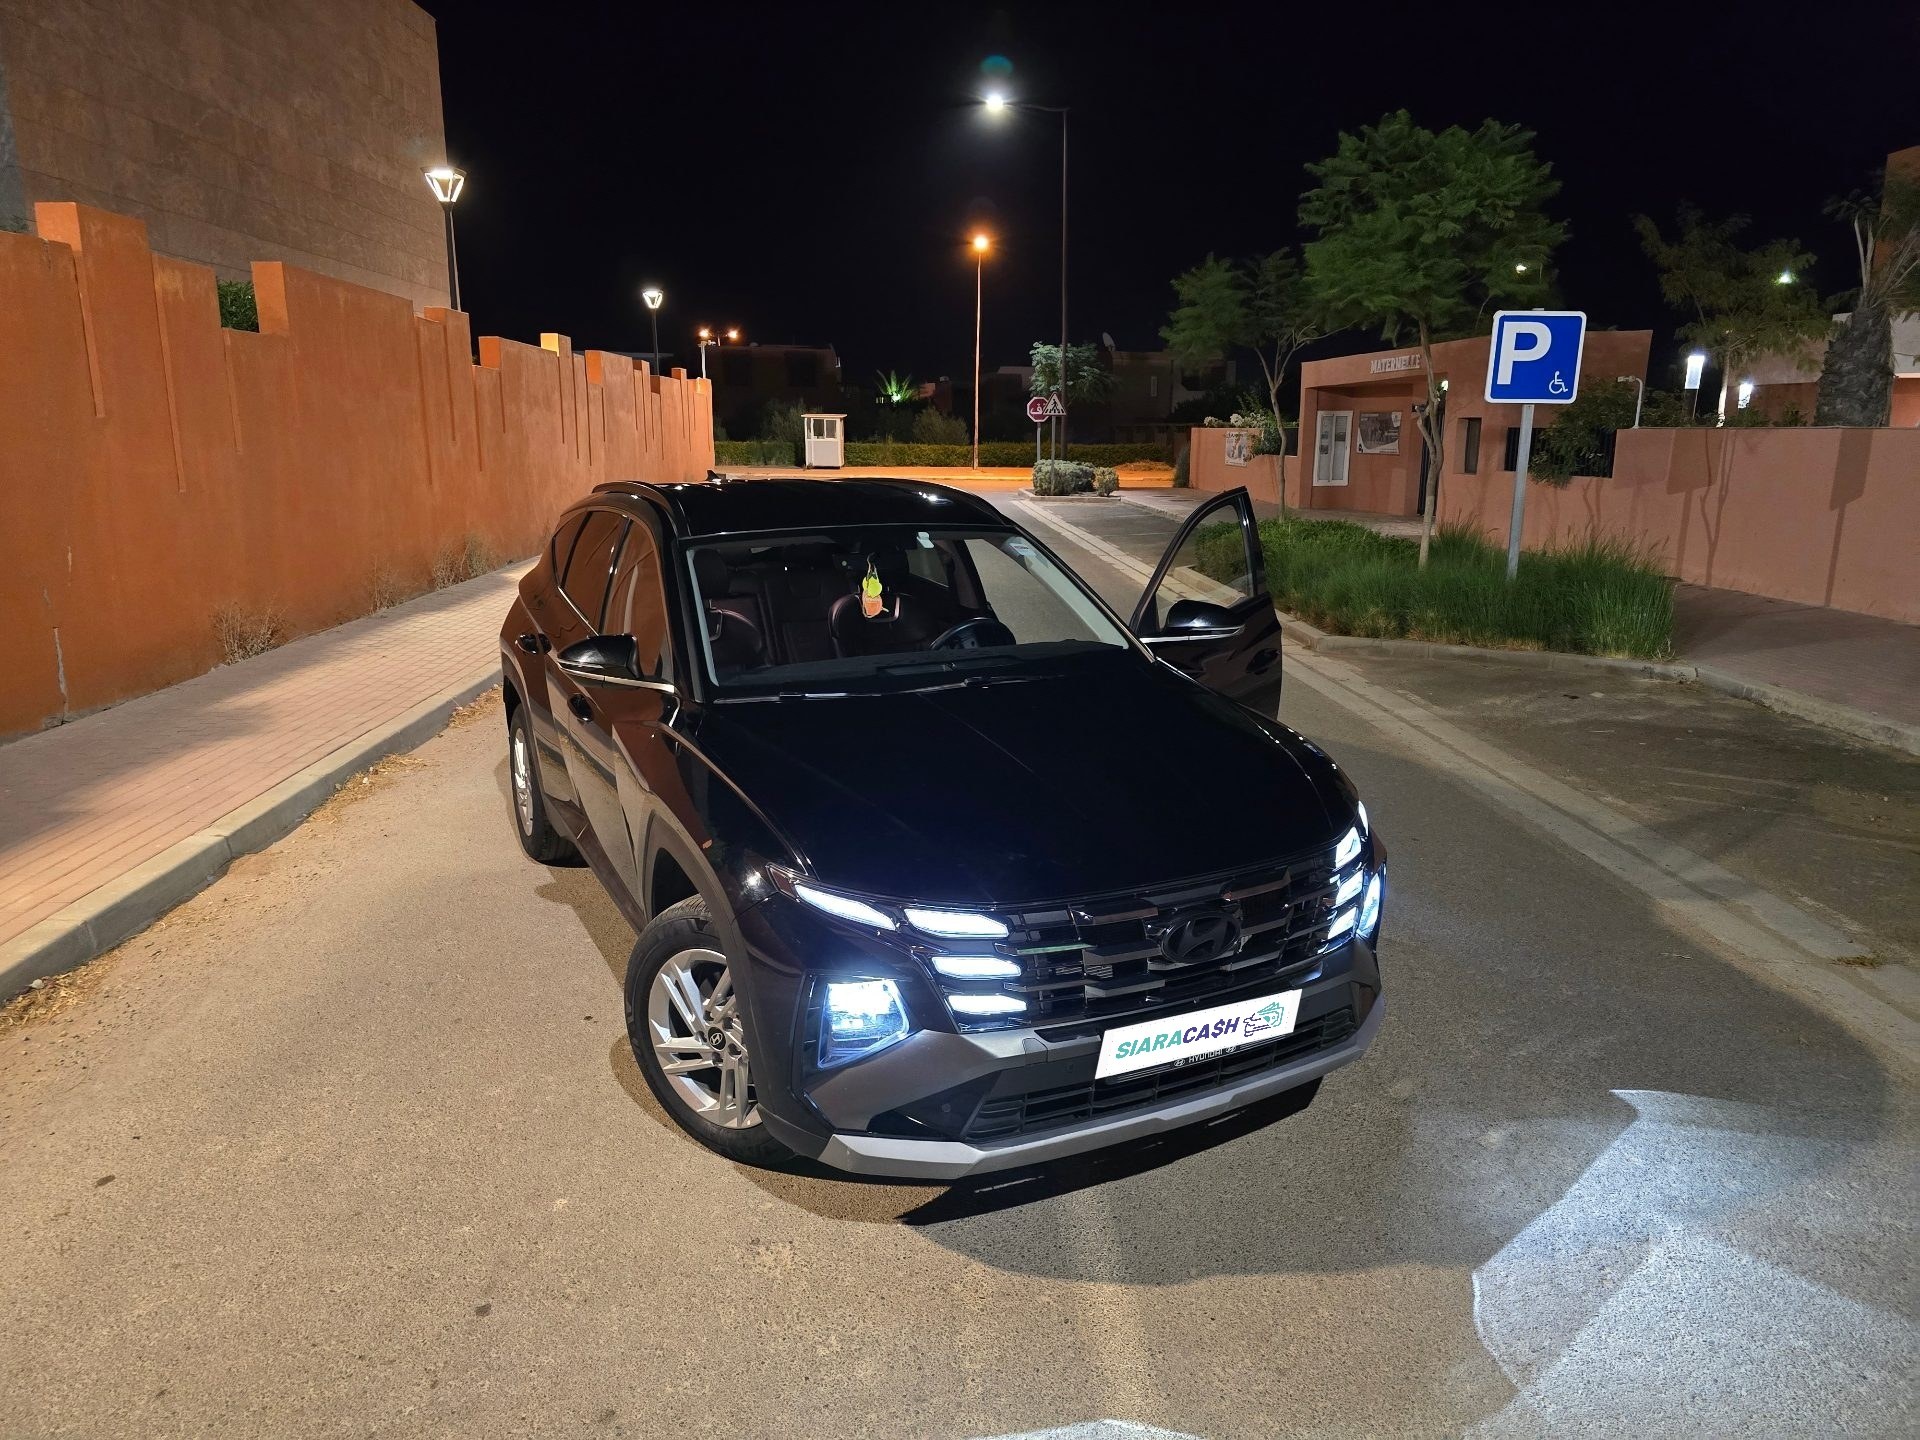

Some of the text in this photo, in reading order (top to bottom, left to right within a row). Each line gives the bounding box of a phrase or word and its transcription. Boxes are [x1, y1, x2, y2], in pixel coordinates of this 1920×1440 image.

[1497, 321, 1551, 385] P
[1370, 354, 1420, 373] MATERNELLE
[1188, 1048, 1223, 1063] HYUNDAI
